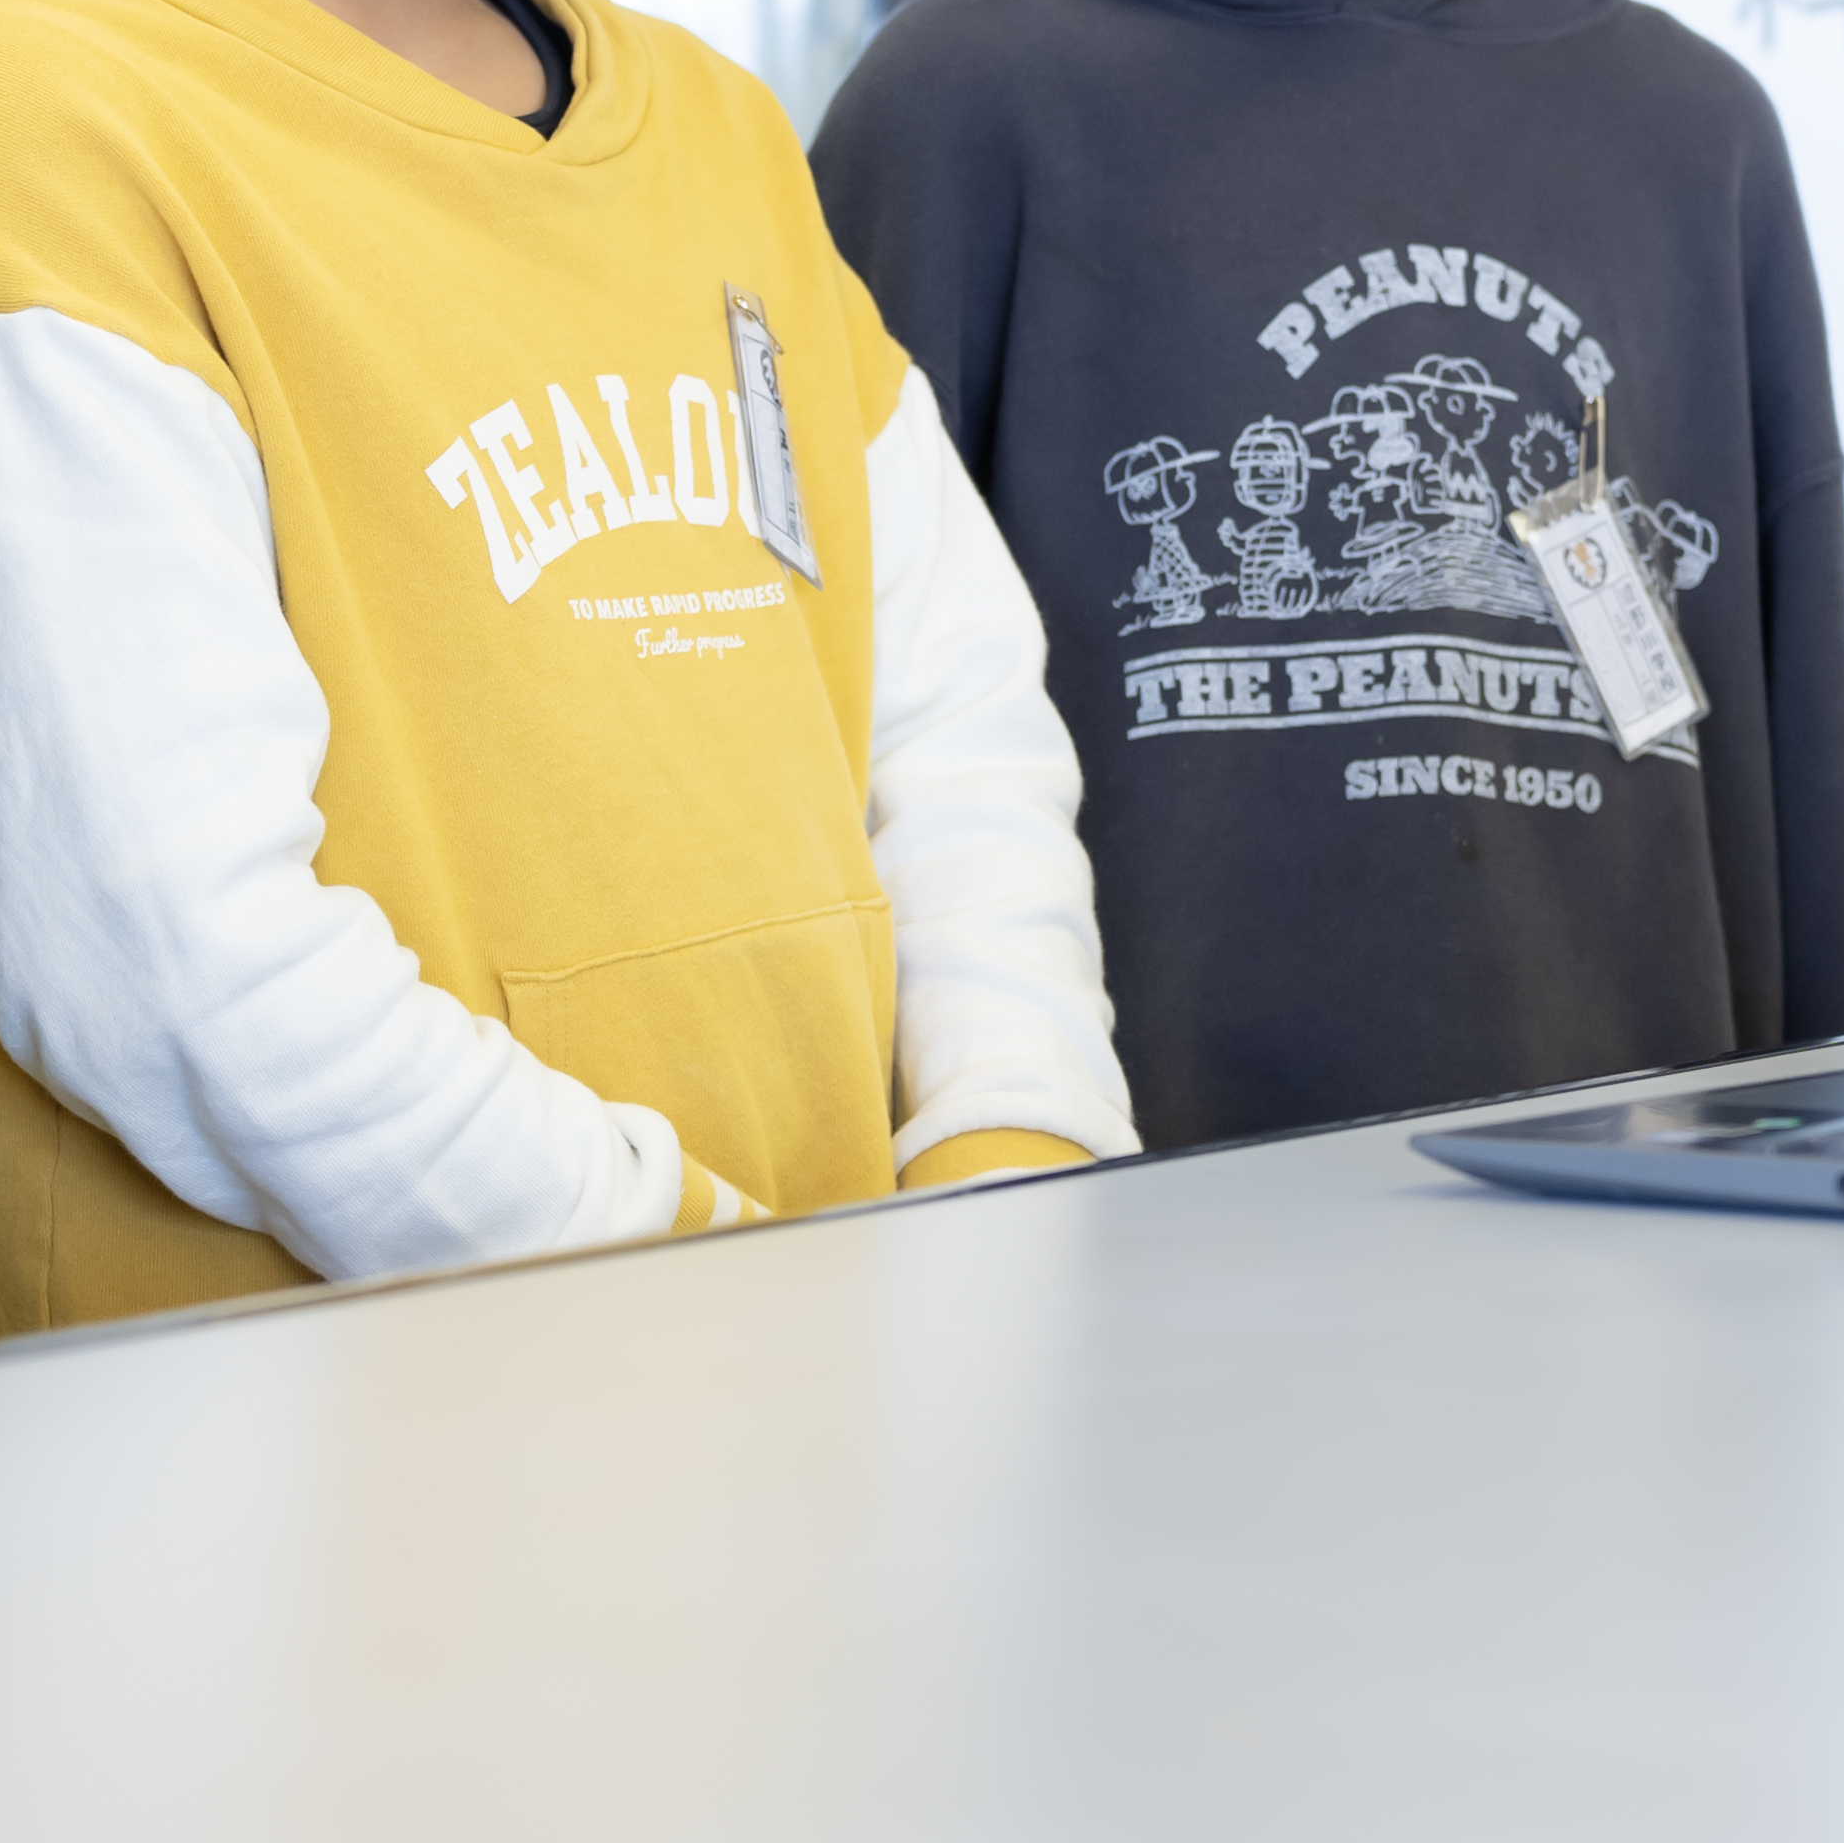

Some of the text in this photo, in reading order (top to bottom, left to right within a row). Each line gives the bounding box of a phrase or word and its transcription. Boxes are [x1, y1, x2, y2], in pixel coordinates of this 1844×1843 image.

[1257, 243, 1616, 396] PEANUTS
[568, 582, 786, 620] TO MAKE RAPID PROGRESS
[635, 626, 694, 659] Further
[1125, 661, 1271, 724] THE
[1285, 650, 1605, 725] PEANUTS
[1345, 755, 1603, 814] SINCE 1950
